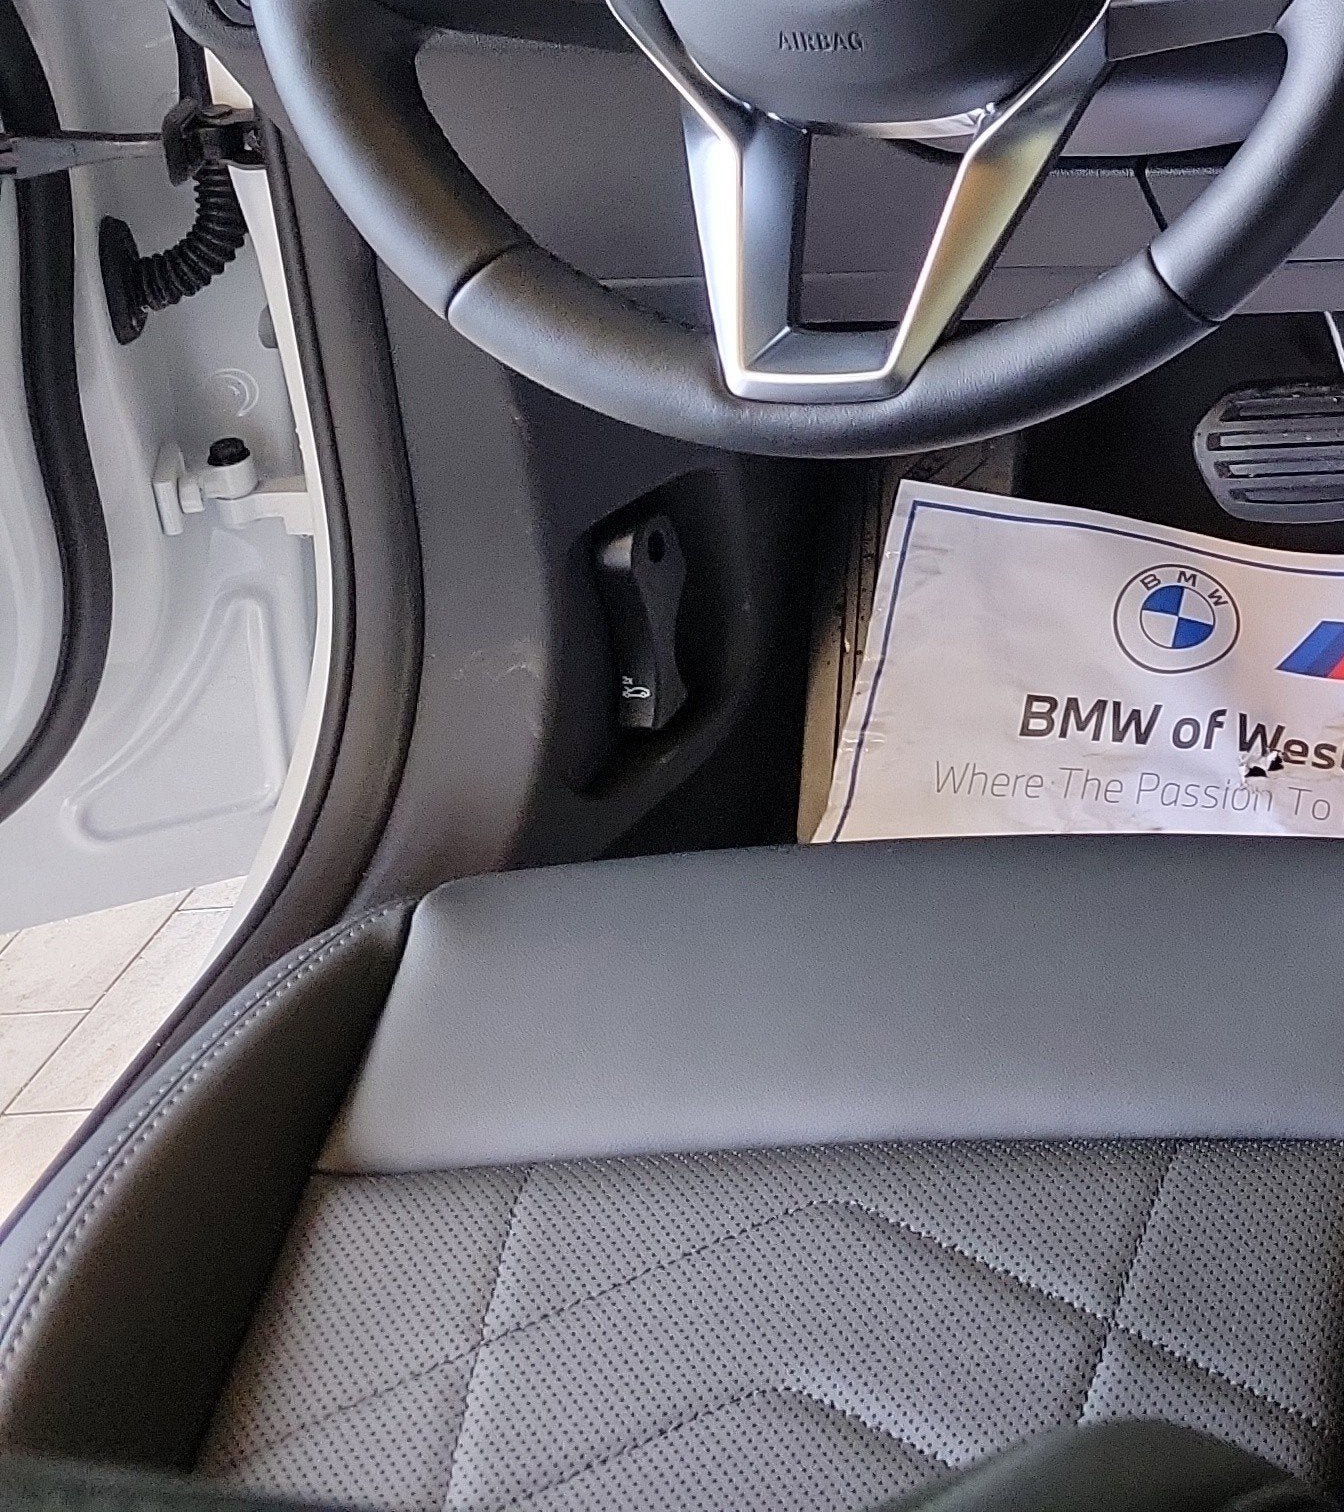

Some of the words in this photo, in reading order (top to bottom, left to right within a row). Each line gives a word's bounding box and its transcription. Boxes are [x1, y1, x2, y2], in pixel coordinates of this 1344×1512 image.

[778, 30, 864, 52] AIRBAG
[1139, 570, 1228, 608] BMW
[1019, 694, 1163, 746] BMW
[1171, 708, 1228, 750] of
[936, 760, 1044, 799] Where
[1059, 766, 1123, 804] The
[1136, 772, 1273, 812] Passion
[1288, 786, 1331, 821] To
